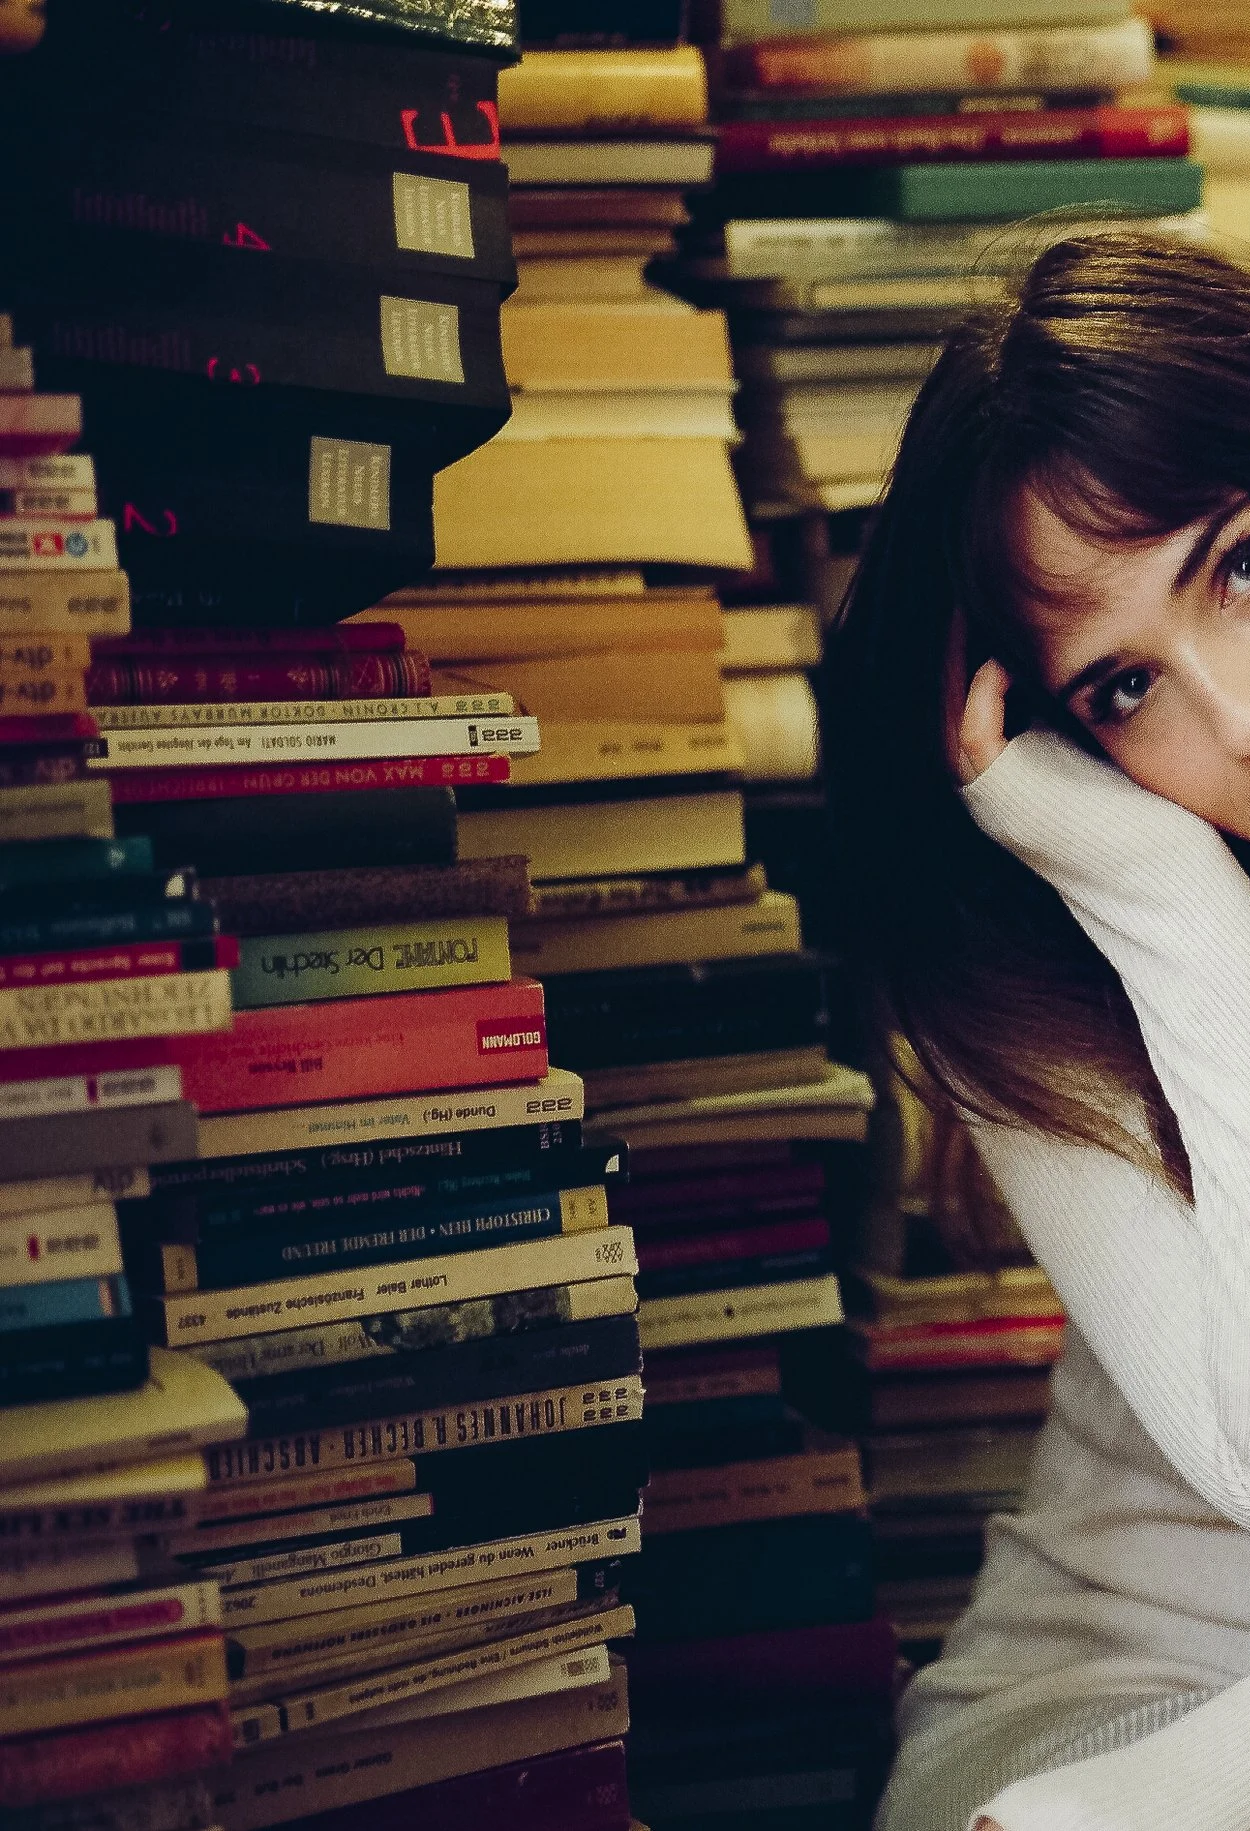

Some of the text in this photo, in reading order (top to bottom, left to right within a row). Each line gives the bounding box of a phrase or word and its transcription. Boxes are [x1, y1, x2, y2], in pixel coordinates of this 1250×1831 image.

[305, 735, 337, 748] MARIO
[301, 770, 331, 787] DER
[334, 767, 379, 785] VON
[383, 765, 425, 782] MAX
[346, 948, 384, 971] Der
[481, 1030, 541, 1049] GOLDMANN
[422, 1106, 453, 1124] (Hg.)
[454, 1105, 496, 1121] Dunde
[439, 1218, 472, 1237] HEIN
[475, 1207, 551, 1233] CHRISTOPH
[339, 1230, 396, 1249] FREMDE
[397, 1225, 426, 1243] DER
[281, 1240, 337, 1261] FREUND
[376, 1281, 407, 1296] Baier
[410, 1274, 447, 1290] Lothar
[456, 1395, 567, 1441] JOHANNES
[343, 1417, 425, 1460] BECHER
[330, 1542, 382, 1562] Giorgio
[544, 1533, 599, 1553] Brückner
[478, 1553, 496, 1566] du
[498, 1546, 535, 1560] Wenn
[428, 1553, 475, 1574] geredet
[299, 1575, 377, 1599] Desdemona
[527, 1587, 552, 1604] ILSE
[480, 1653, 501, 1666] Eine
